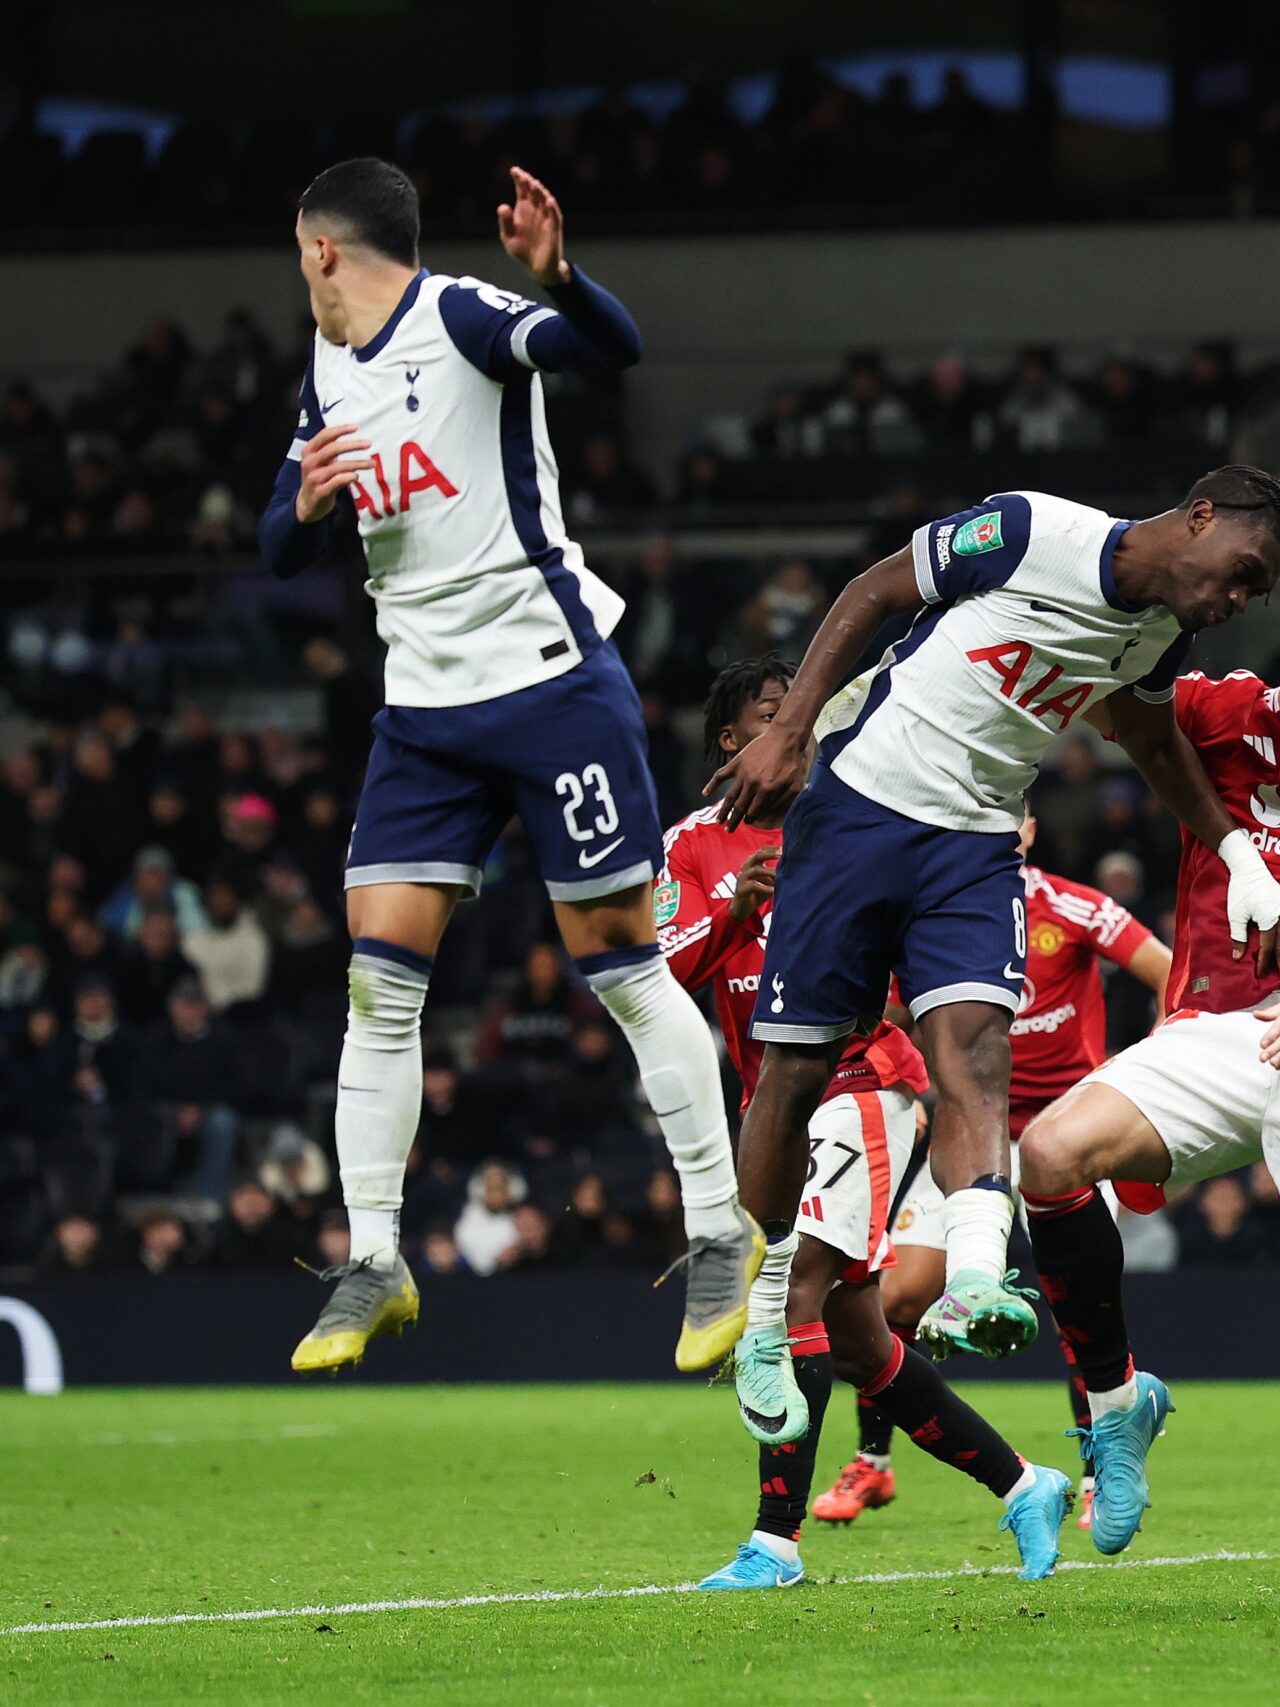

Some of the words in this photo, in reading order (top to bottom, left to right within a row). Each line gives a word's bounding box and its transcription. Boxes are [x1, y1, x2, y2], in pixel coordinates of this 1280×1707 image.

[965, 640, 1094, 729] AIA
[555, 763, 619, 841] 23
[1012, 897, 1026, 959] 8
